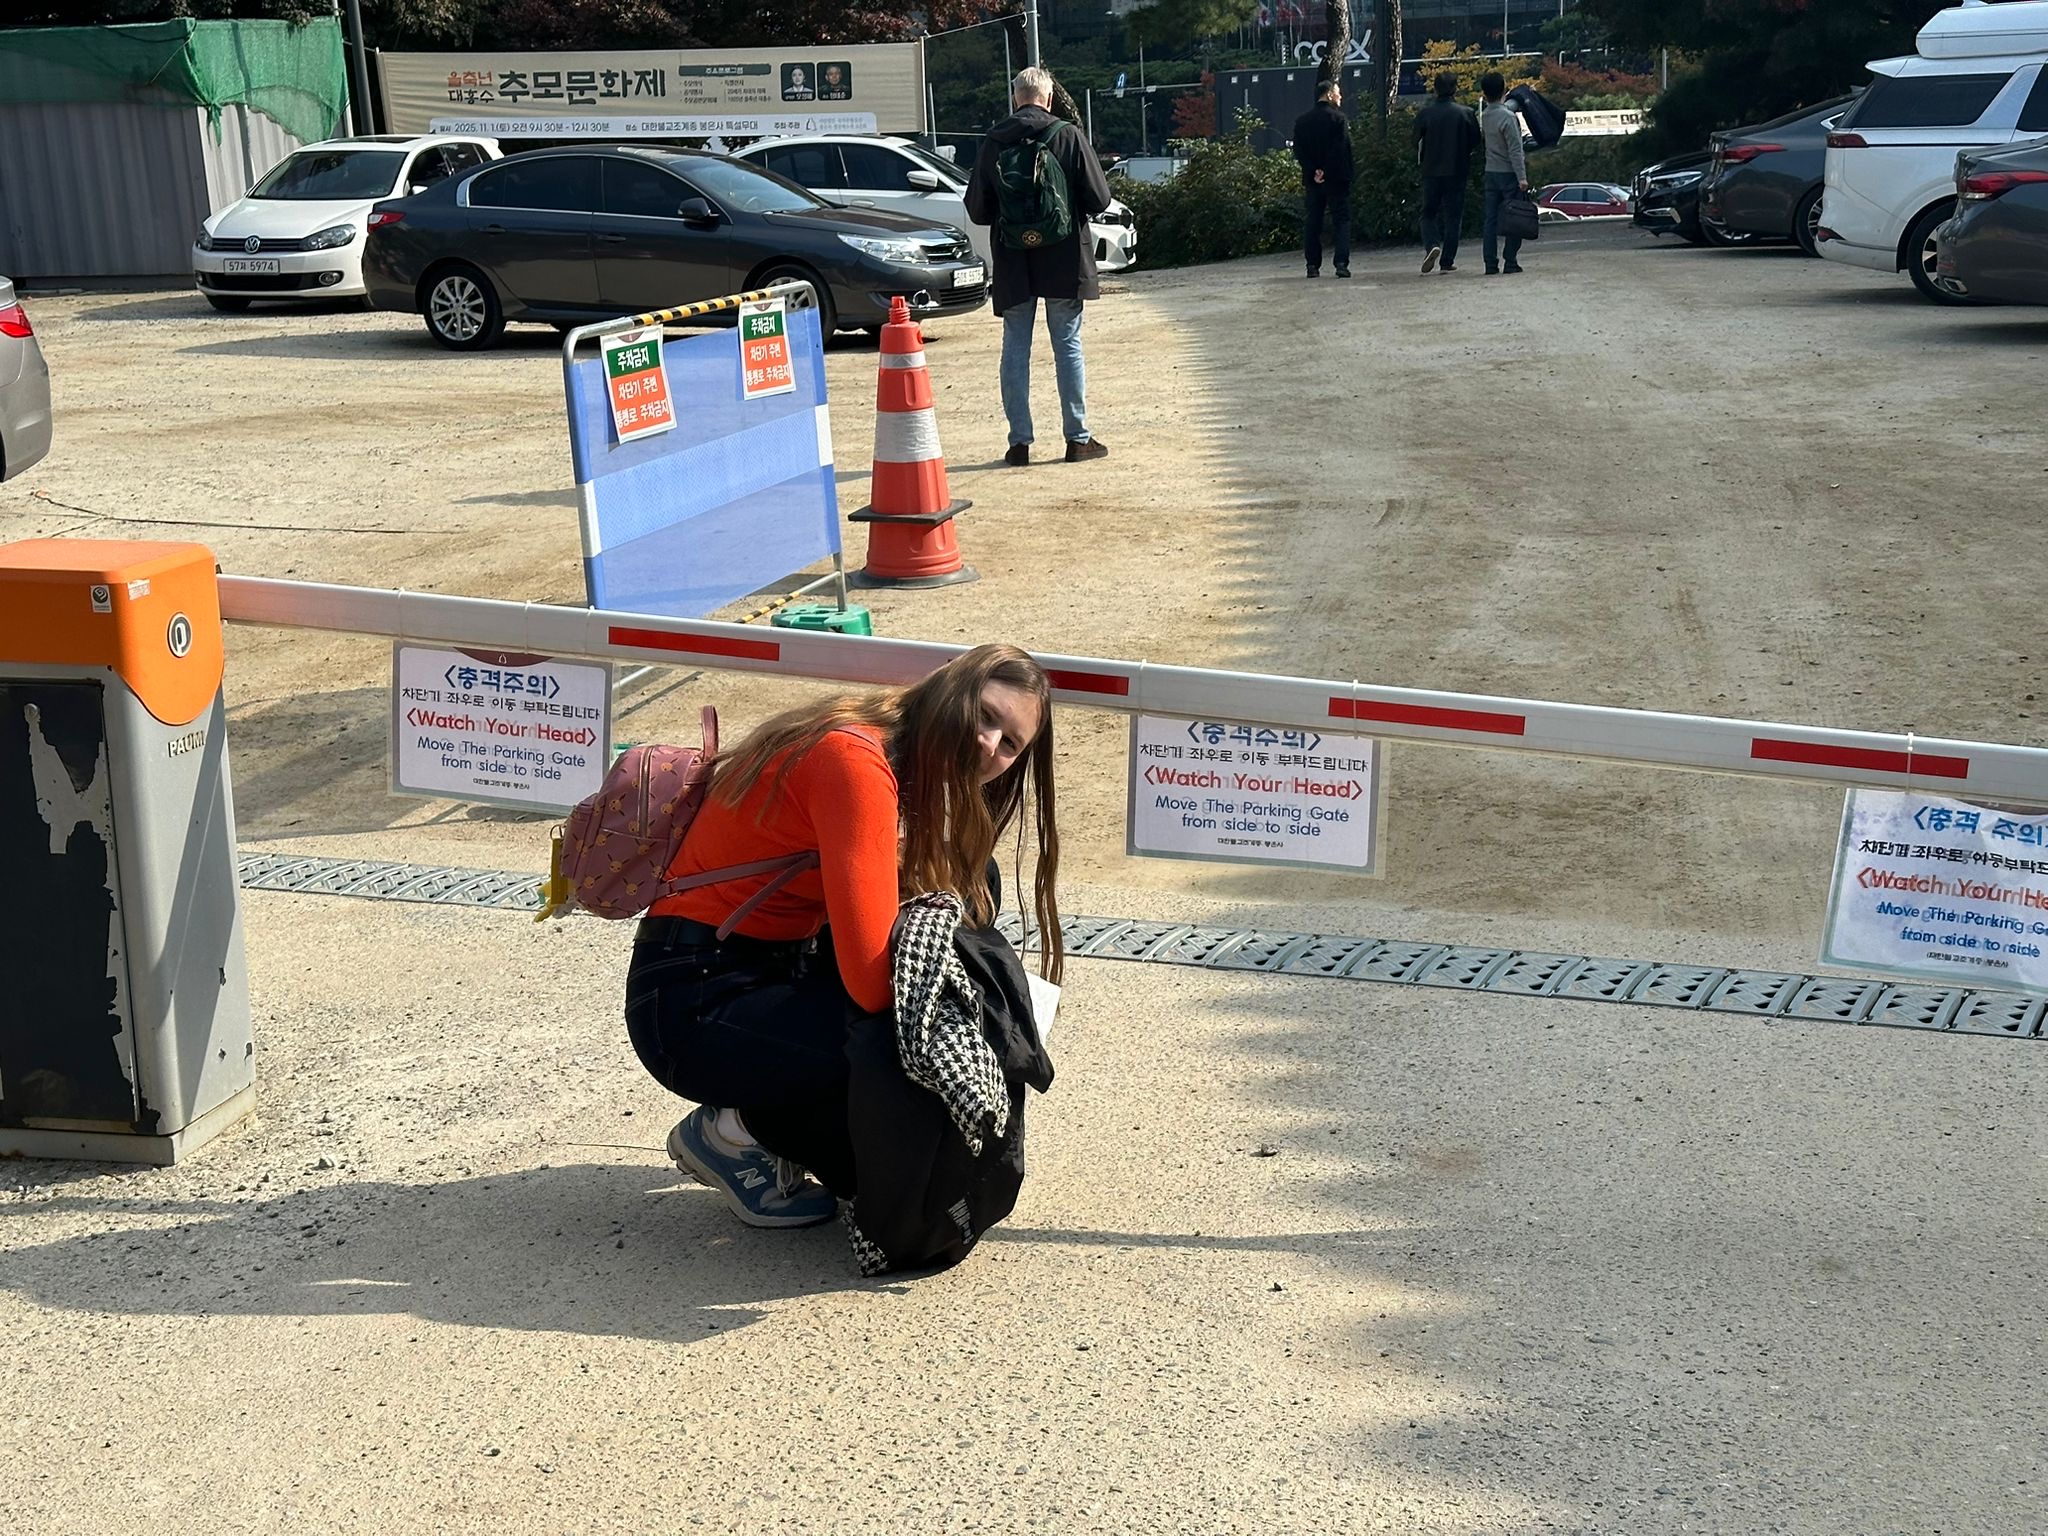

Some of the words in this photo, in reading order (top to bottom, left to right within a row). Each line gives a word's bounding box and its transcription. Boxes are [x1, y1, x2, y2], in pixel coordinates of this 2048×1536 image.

[1294, 29, 1371, 62] cox
[447, 71, 492, 87] 을축년
[498, 69, 666, 105] 추모문화제
[448, 89, 495, 104] 대홍수
[512, 123, 528, 132] 오전
[529, 122, 542, 132] 9시
[544, 122, 563, 132] 30분
[571, 122, 588, 132] 12시
[590, 122, 609, 132] 30분
[250, 261, 274, 271] 5974
[751, 315, 775, 336] 주차금지
[617, 346, 650, 371] 주차금지
[750, 345, 768, 361] 차단기
[766, 364, 791, 382] 주차금지
[618, 379, 642, 400] 차단기
[642, 375, 658, 395] 주변
[640, 398, 670, 420] 주차금지
[402, 688, 440, 703] 차단기
[447, 692, 484, 707] 좌우로
[492, 698, 516, 711] 이동
[523, 701, 600, 720] 부탁드립니다
[485, 717, 527, 735] Your
[418, 736, 454, 751] Move
[462, 741, 487, 756] The
[494, 745, 544, 765] Parking
[552, 752, 586, 767] Gate
[1140, 744, 1182, 758] 차단기
[1190, 747, 1233, 763] 좌우로
[1242, 752, 1269, 766] 이동
[1278, 753, 1368, 772] 부탁드립니다
[441, 755, 472, 770] from
[479, 759, 507, 774] side
[514, 763, 527, 776] to
[534, 765, 562, 780] side
[1234, 773, 1282, 792] Your
[1155, 795, 1197, 811] Move
[1206, 798, 1234, 814] The
[1243, 801, 1301, 821] Parking
[1310, 807, 1350, 822] Gate
[1182, 814, 1216, 829] from
[1225, 817, 1257, 832] side
[1266, 820, 1280, 833] to
[1289, 821, 1321, 836] side
[1992, 817, 2048, 847] 주의
[1914, 845, 1963, 863] 좌우로
[1957, 878, 2013, 902] Your
[1879, 901, 1920, 918] Move
[1929, 906, 1956, 922] The
[1966, 911, 2025, 933] Parking
[1902, 926, 1936, 942] from
[1945, 934, 1977, 948] side
[1986, 937, 2000, 951] to
[2009, 943, 2041, 957] side
